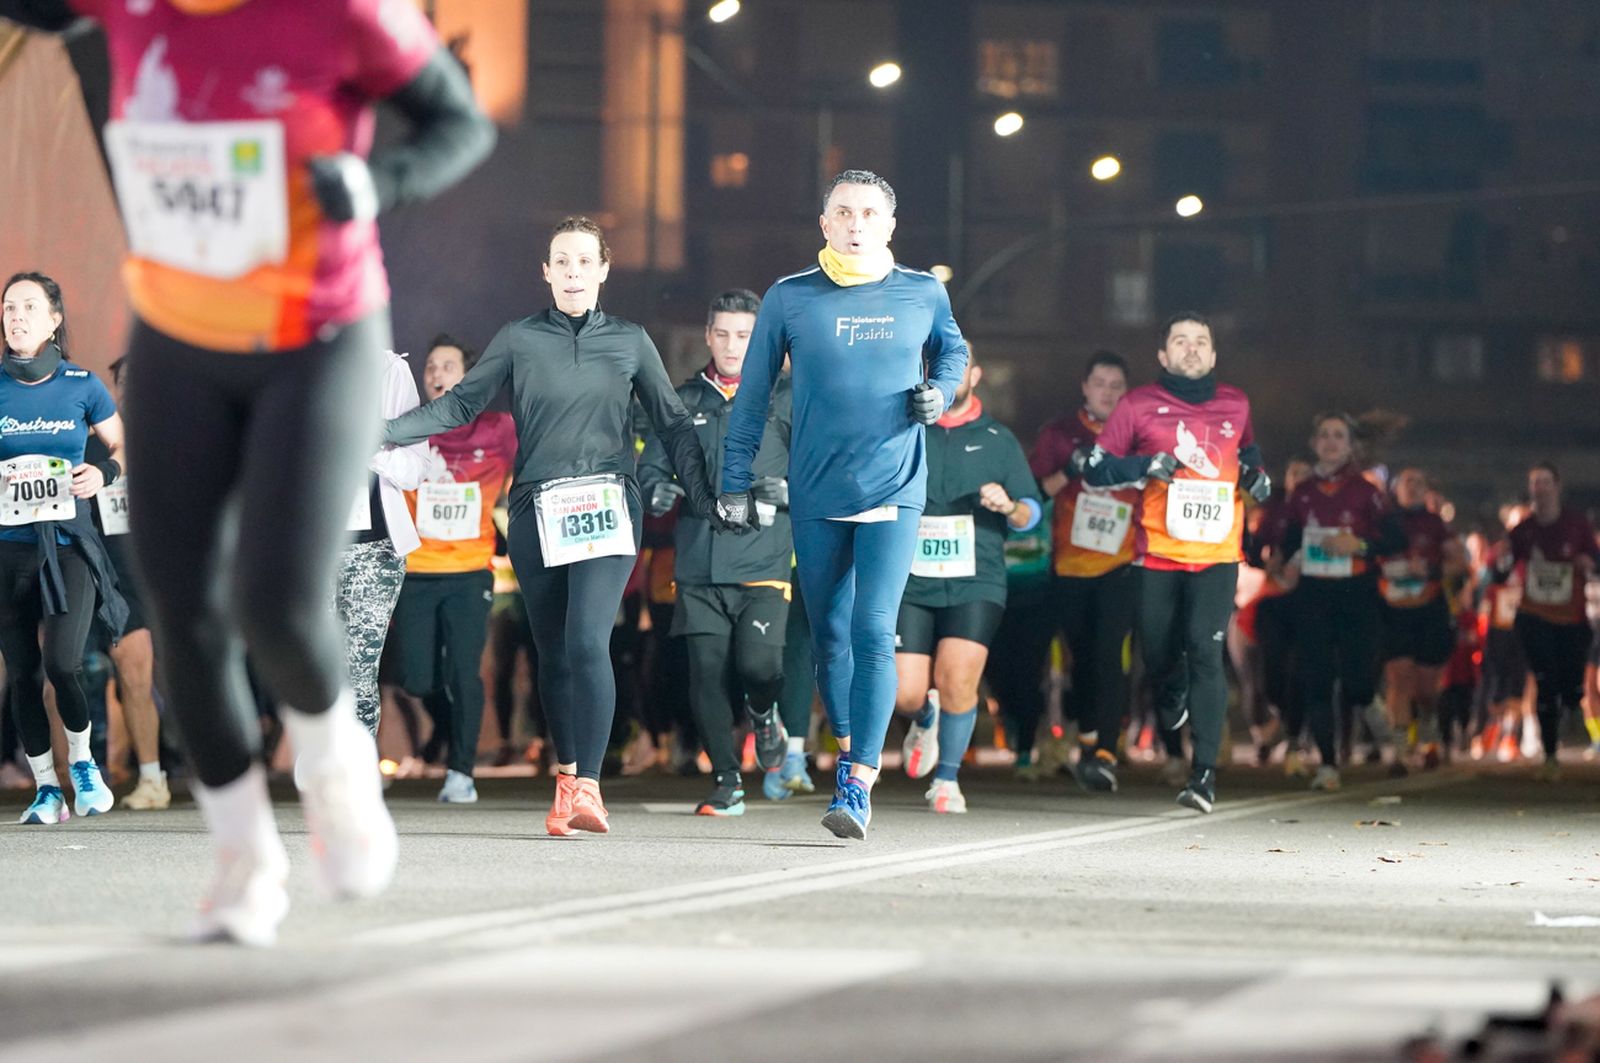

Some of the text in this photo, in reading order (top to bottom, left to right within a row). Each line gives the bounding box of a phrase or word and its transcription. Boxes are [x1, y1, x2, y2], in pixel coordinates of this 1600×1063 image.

[10, 477, 58, 502] 7000
[561, 493, 597, 505] NOCHE DE
[432, 504, 468, 520] 6077
[1182, 502, 1222, 521] 6792
[556, 508, 619, 538] 13319
[922, 539, 959, 556] 6791
